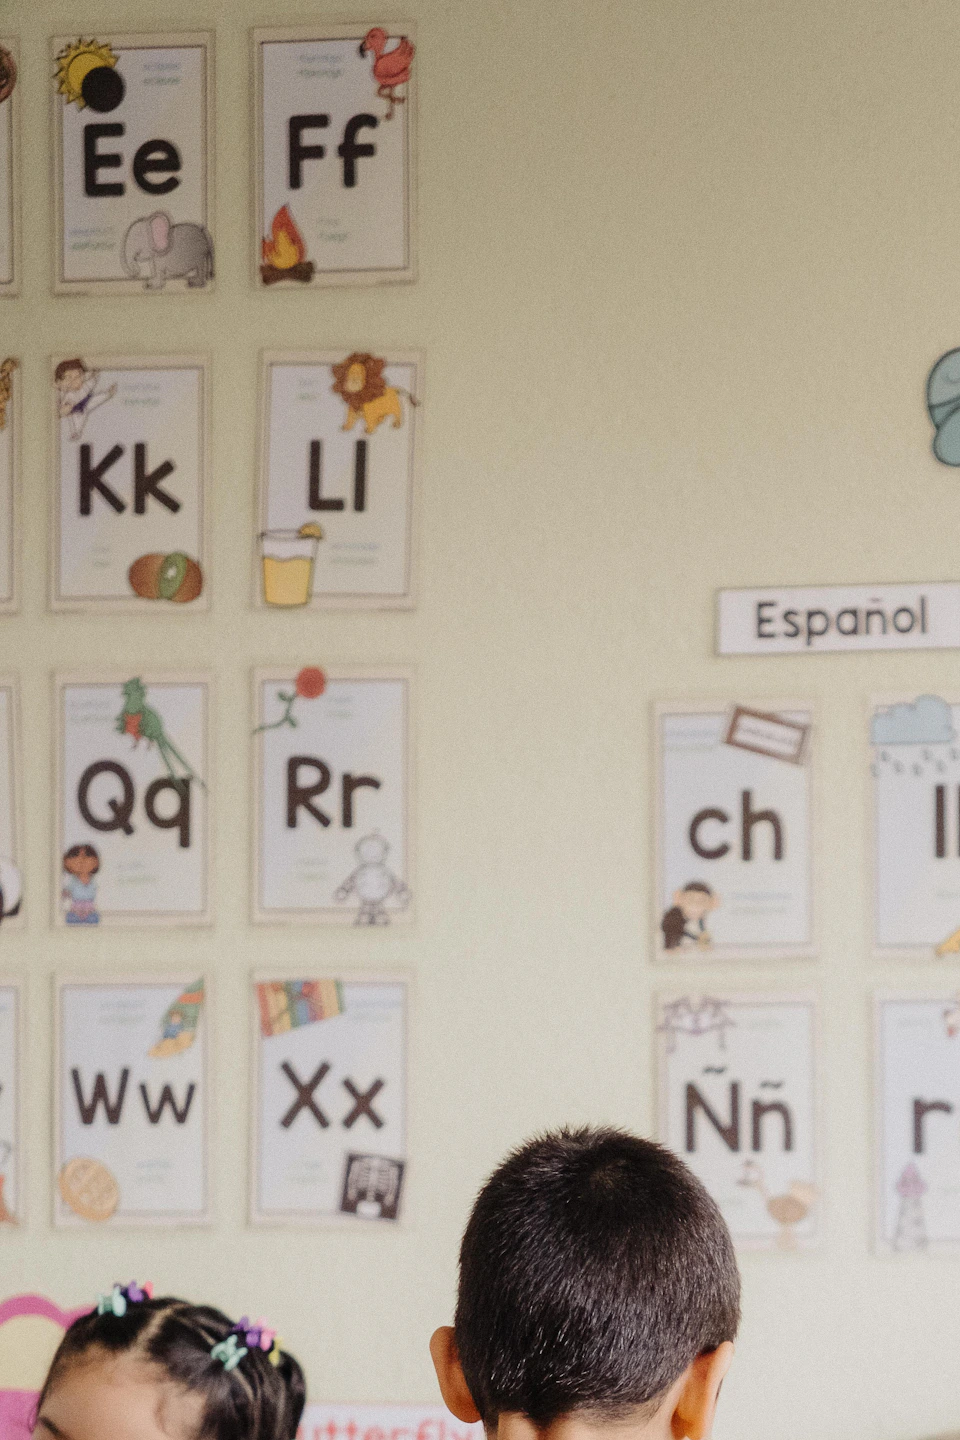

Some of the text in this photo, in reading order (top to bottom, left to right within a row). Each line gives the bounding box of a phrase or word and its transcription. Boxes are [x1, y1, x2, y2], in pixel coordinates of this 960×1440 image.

[82, 121, 183, 198] Ee
[287, 113, 379, 190] Ff
[78, 442, 182, 517] Kk
[307, 439, 369, 513] Ll
[755, 597, 927, 647] Español
[77, 760, 193, 849] Qq
[285, 755, 382, 830] Rr
[687, 788, 785, 862] ch
[70, 1067, 196, 1126] Ww
[280, 1061, 385, 1130] Xx
[684, 1064, 793, 1154] Ññ
